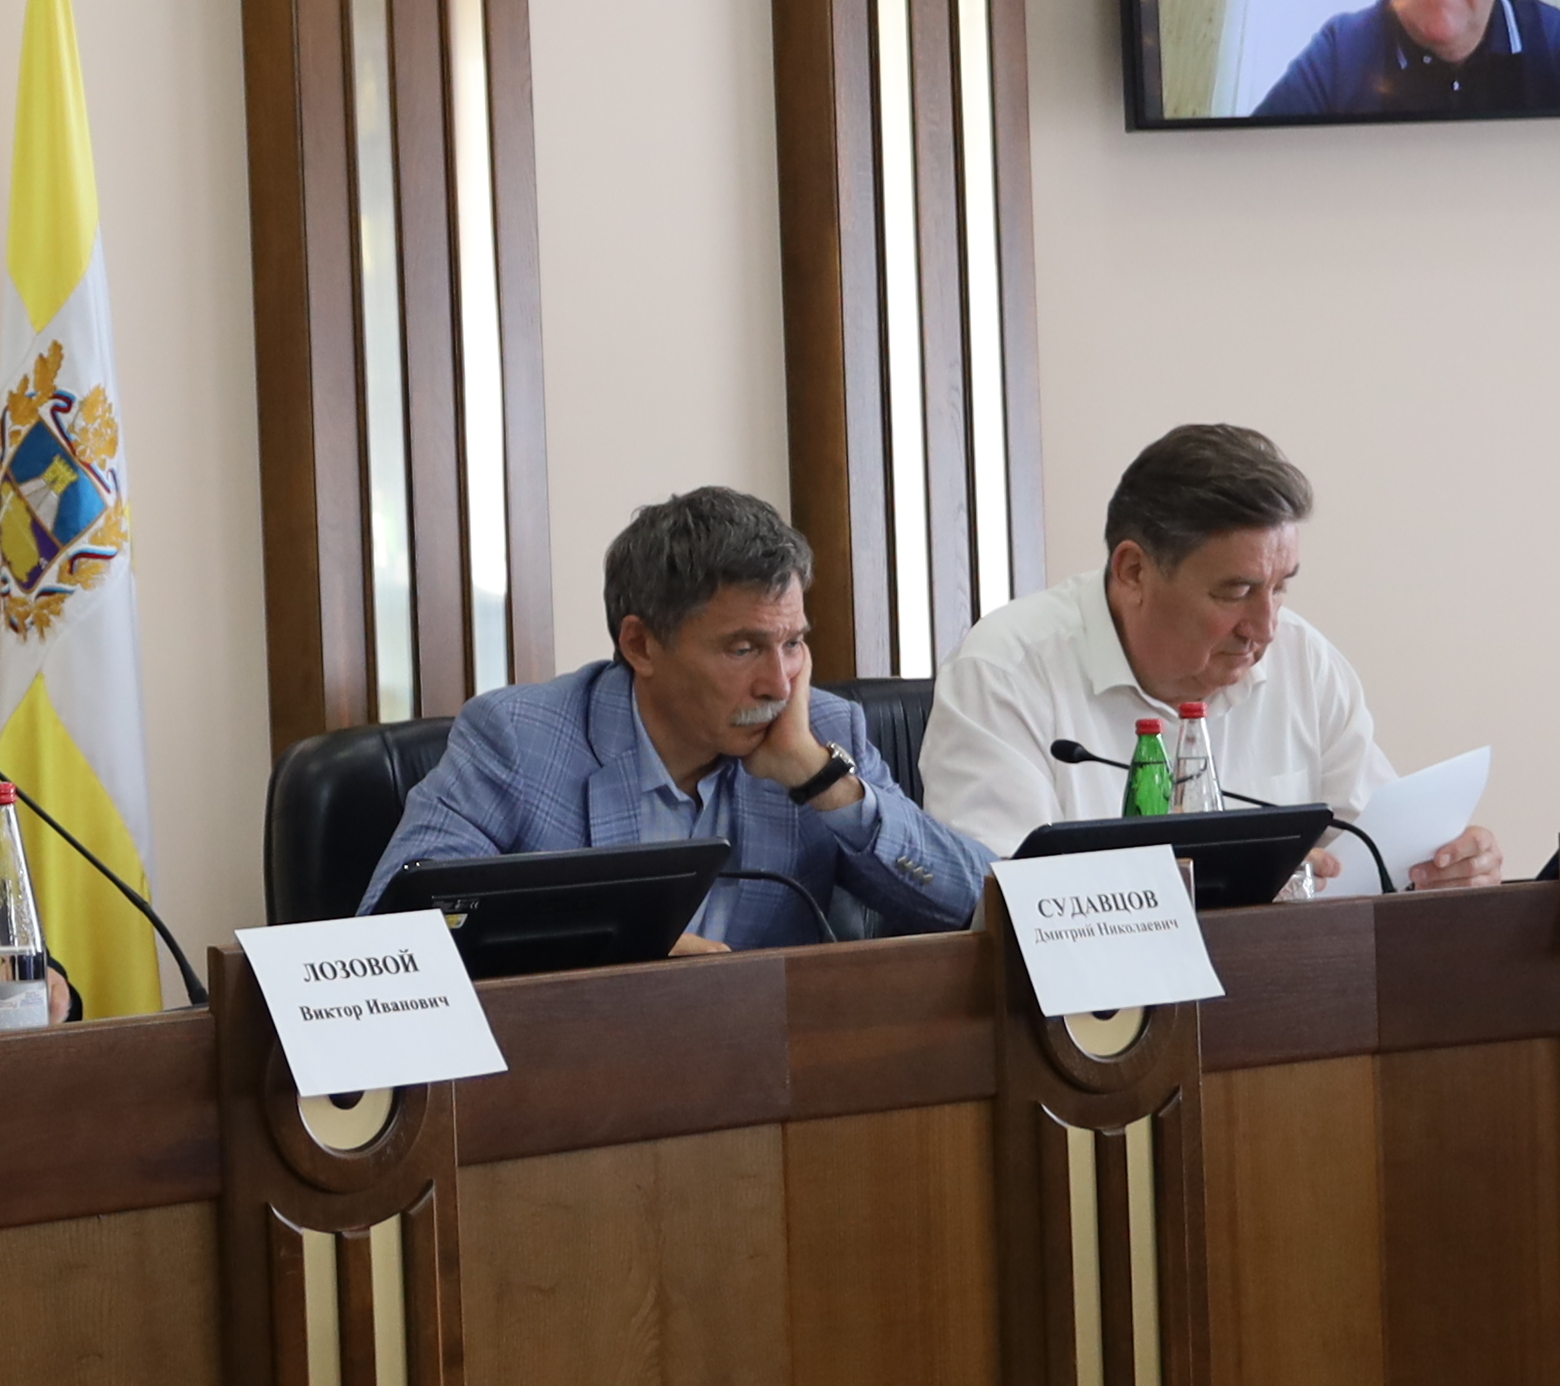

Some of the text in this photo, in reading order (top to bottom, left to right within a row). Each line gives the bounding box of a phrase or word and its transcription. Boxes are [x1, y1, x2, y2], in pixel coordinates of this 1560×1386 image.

[1037, 890, 1159, 918] СУДАВЦОВ
[1035, 919, 1179, 944] Дмитрий Николаевич
[303, 949, 420, 983] ЛОЗОВОЙ
[299, 996, 450, 1022] Виктор Иванович
